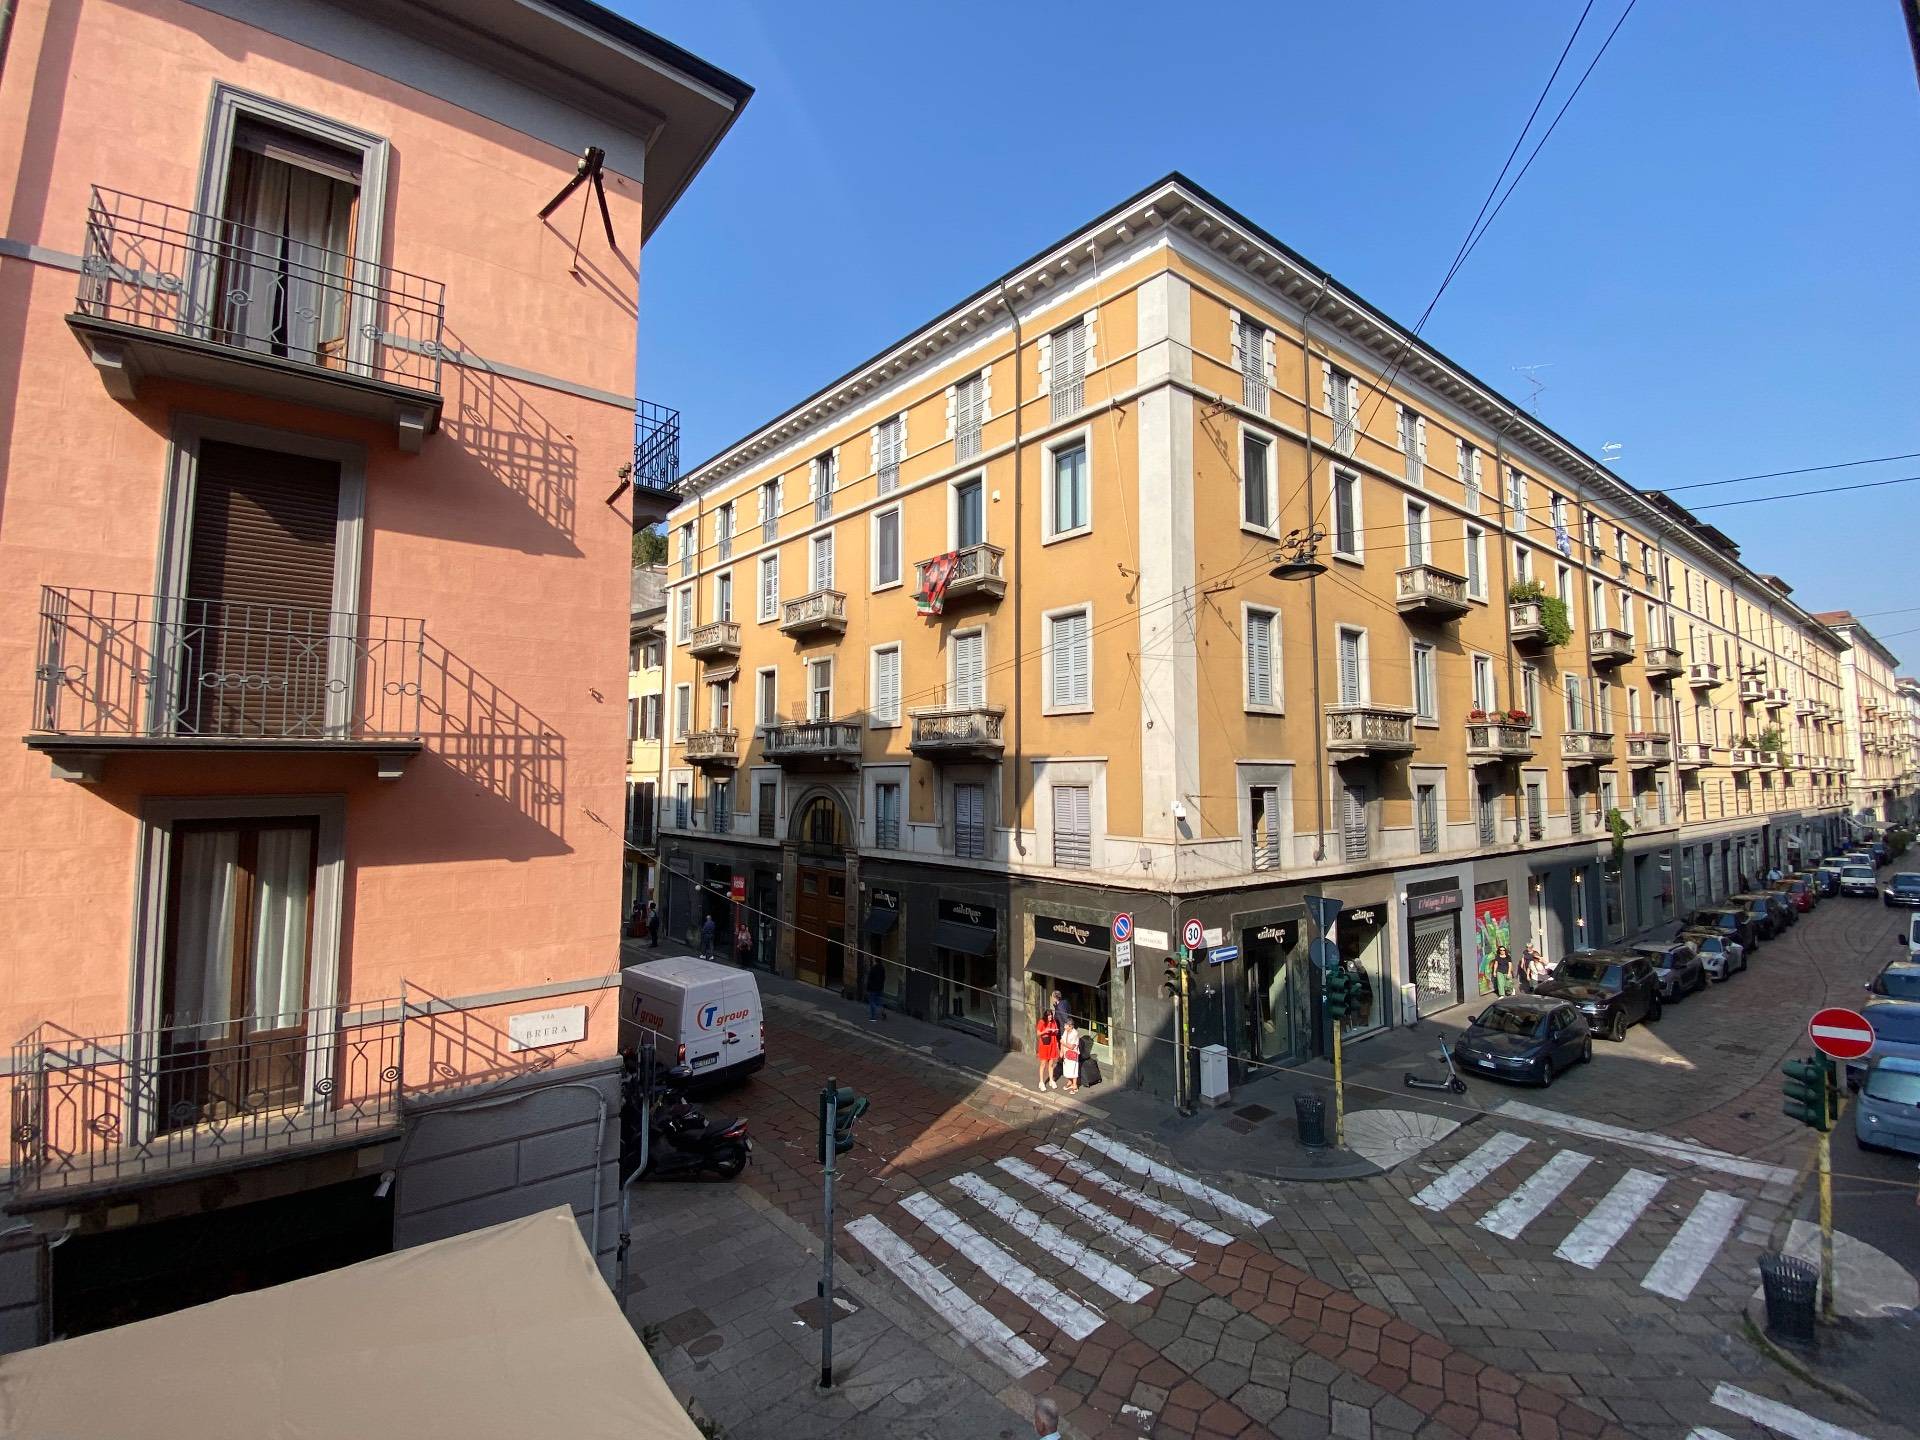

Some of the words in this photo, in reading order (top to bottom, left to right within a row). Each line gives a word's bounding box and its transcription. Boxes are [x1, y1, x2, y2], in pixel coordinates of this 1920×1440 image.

[1188, 928, 1199, 941] 30
[640, 1010, 664, 1030] group
[716, 1008, 750, 1027] group
[526, 1025, 568, 1039] BRERA
